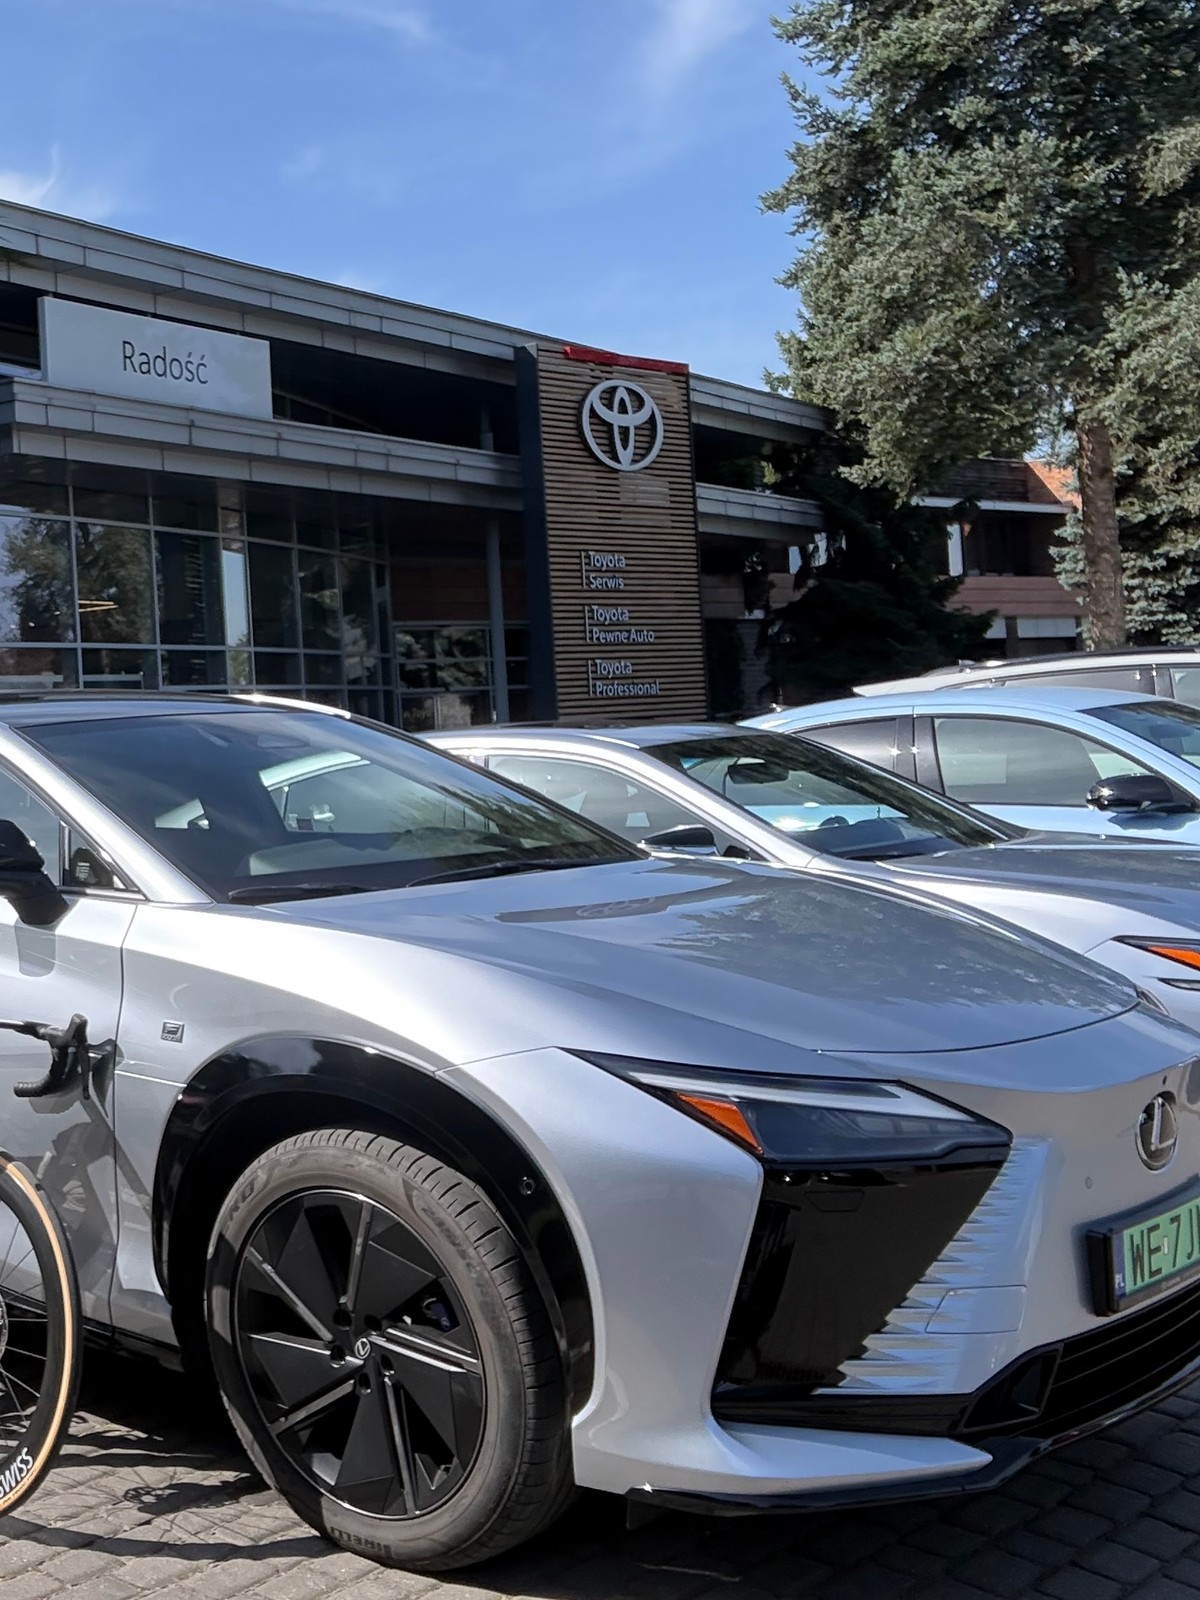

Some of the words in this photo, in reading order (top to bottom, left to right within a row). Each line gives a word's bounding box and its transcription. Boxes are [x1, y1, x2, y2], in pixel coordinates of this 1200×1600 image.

[122, 340, 208, 385] Radość
[588, 551, 626, 571] Toyota
[589, 574, 625, 589] Serwis
[591, 605, 629, 624] Toyota
[592, 627, 630, 643] Pewne
[630, 629, 655, 643] Auto
[595, 659, 633, 678] Toyota
[595, 679, 660, 697] Professional
[1129, 1223, 1163, 1286] WE
[1169, 1205, 1200, 1268] 7J
